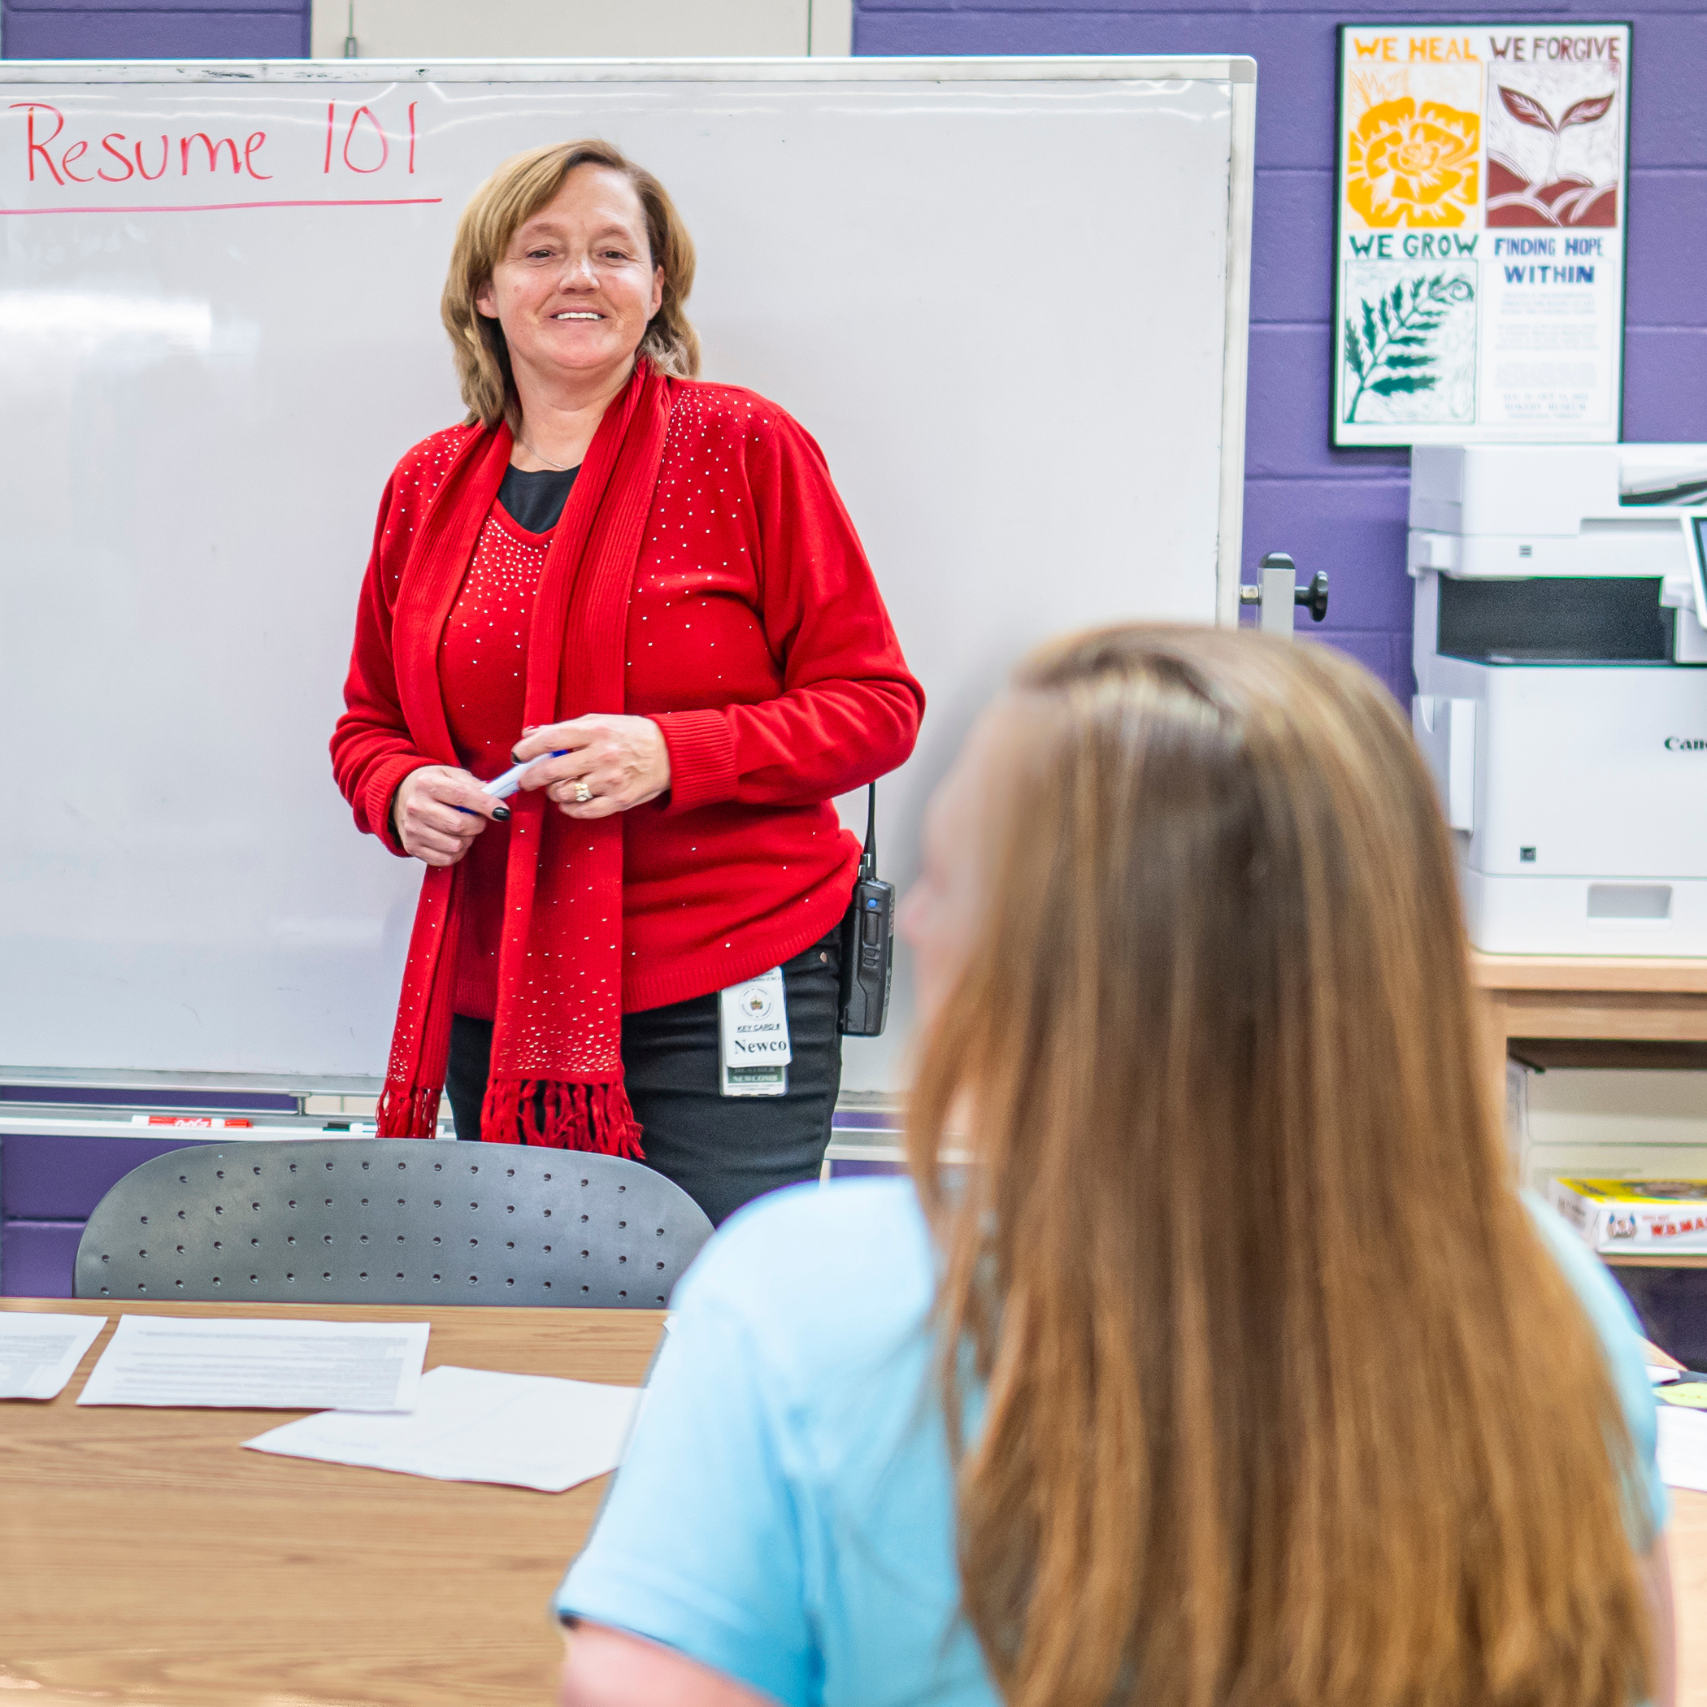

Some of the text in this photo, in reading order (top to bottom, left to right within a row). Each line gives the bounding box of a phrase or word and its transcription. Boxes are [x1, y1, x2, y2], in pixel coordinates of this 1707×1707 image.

[1354, 37, 1480, 62] WE HEAL
[1489, 36, 1620, 61] WE FORGIVE
[9, 98, 418, 185] Resume 101
[1349, 233, 1479, 258] WE GROW
[1494, 237, 1604, 256] FINDING HOPE
[1504, 265, 1595, 284] WITHIN
[1664, 736, 1707, 751] Can
[737, 1024, 752, 1032] KEY
[754, 1023, 775, 1032] CARD
[734, 1040, 787, 1054] Newco
